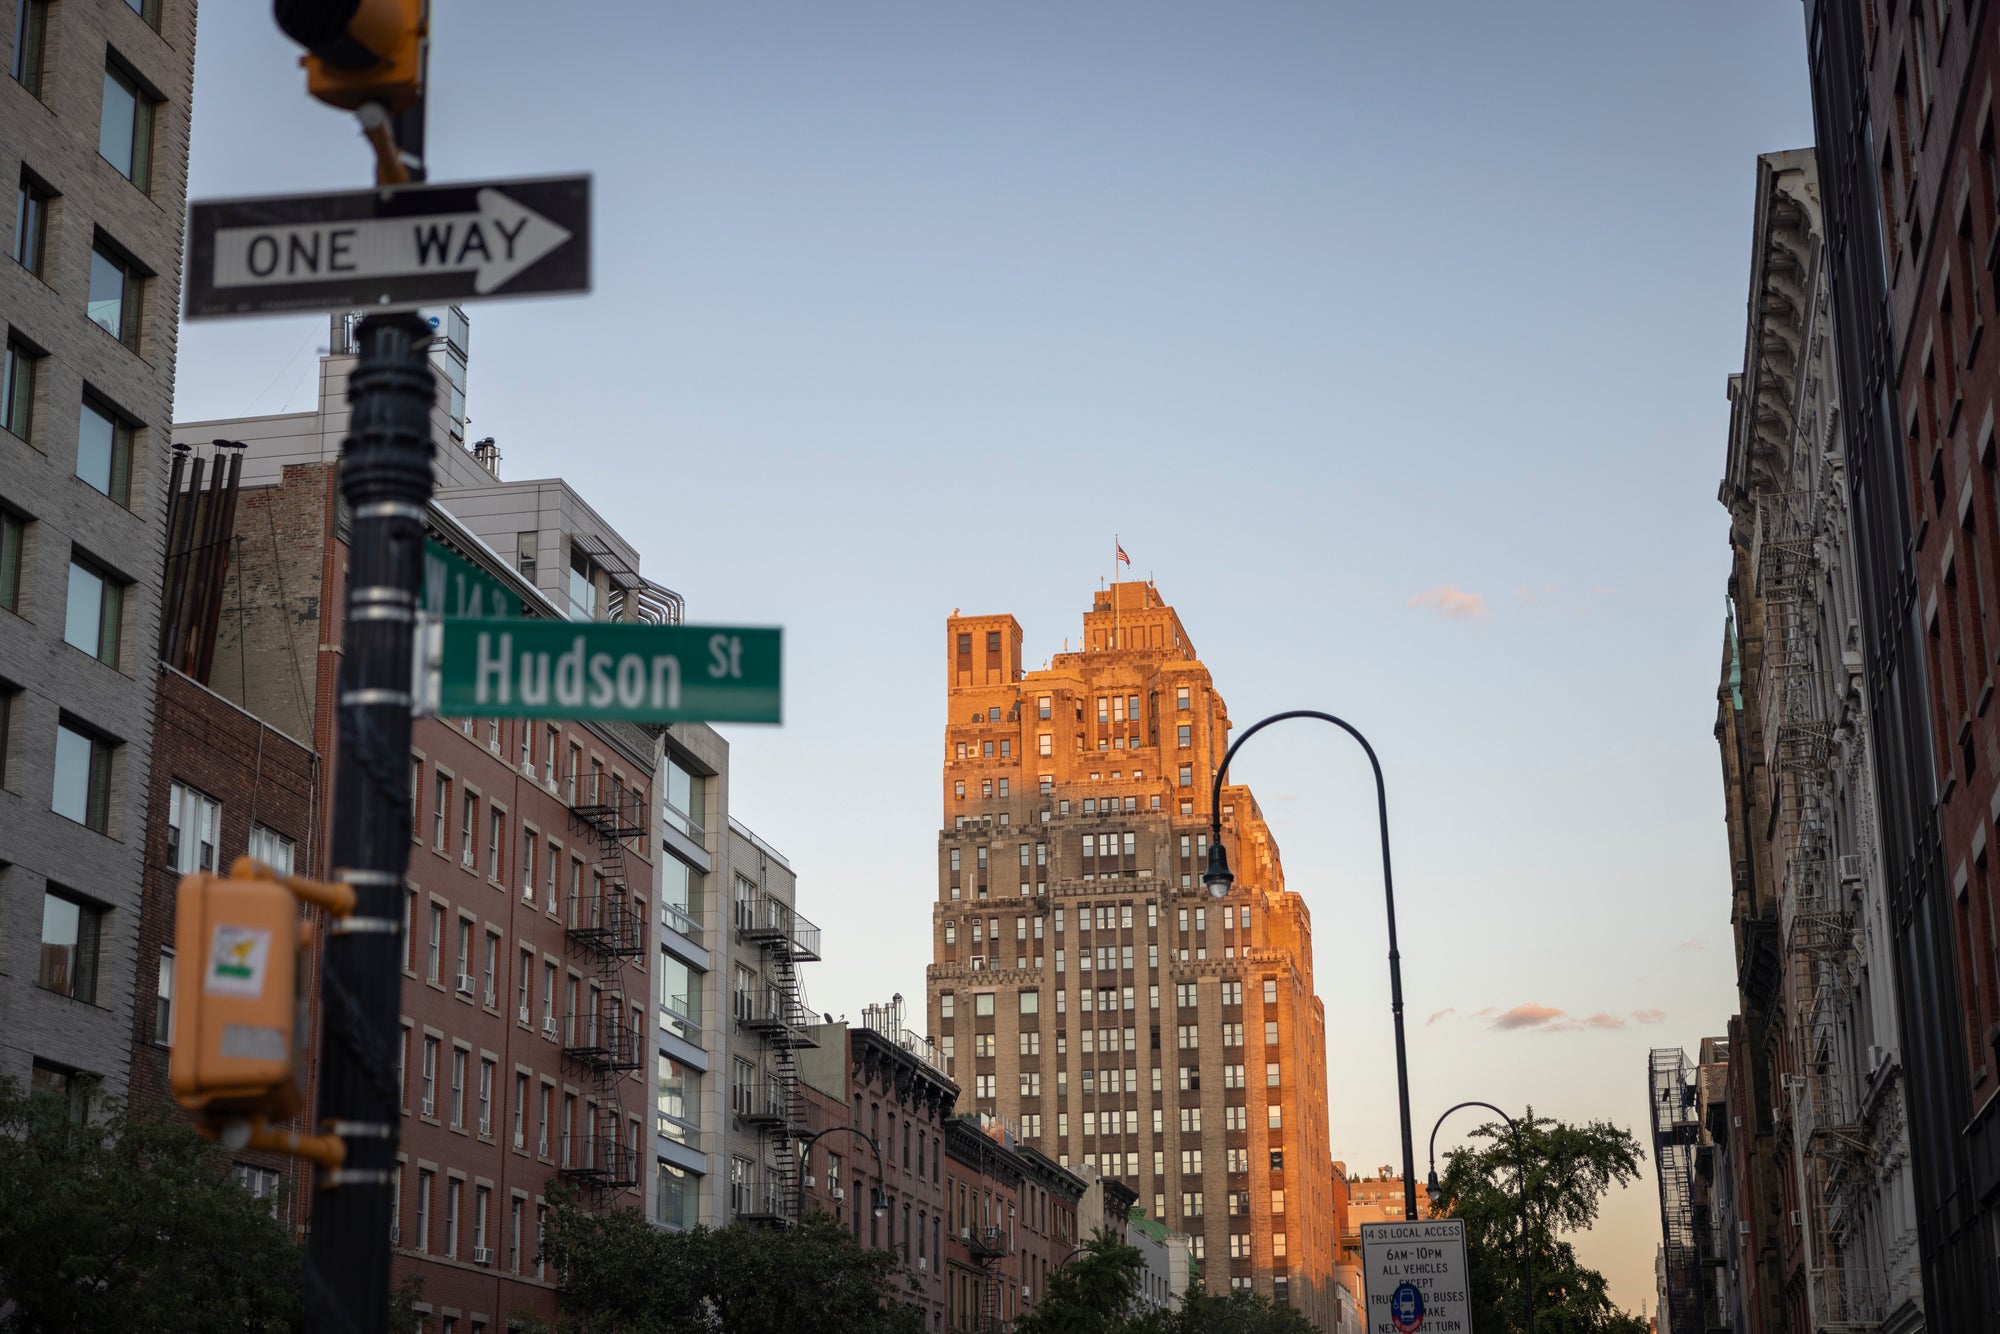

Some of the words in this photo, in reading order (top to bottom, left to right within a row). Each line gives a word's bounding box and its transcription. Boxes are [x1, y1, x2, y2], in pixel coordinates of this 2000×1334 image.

[247, 229, 356, 277] ONE
[414, 217, 529, 266] WAY
[475, 631, 682, 709] Hudson
[708, 633, 744, 679] St
[1365, 1230, 1374, 1239] 14
[1378, 1229, 1388, 1239] St
[1391, 1227, 1421, 1239] LOCAL
[1424, 1226, 1460, 1237] ACCESS
[1383, 1266, 1400, 1275] ALL
[1404, 1263, 1448, 1275] VEHICLES
[1433, 1291, 1464, 1302] BUSES
[1379, 1323, 1396, 1333] NEX
[1436, 1321, 1460, 1332] TURN
